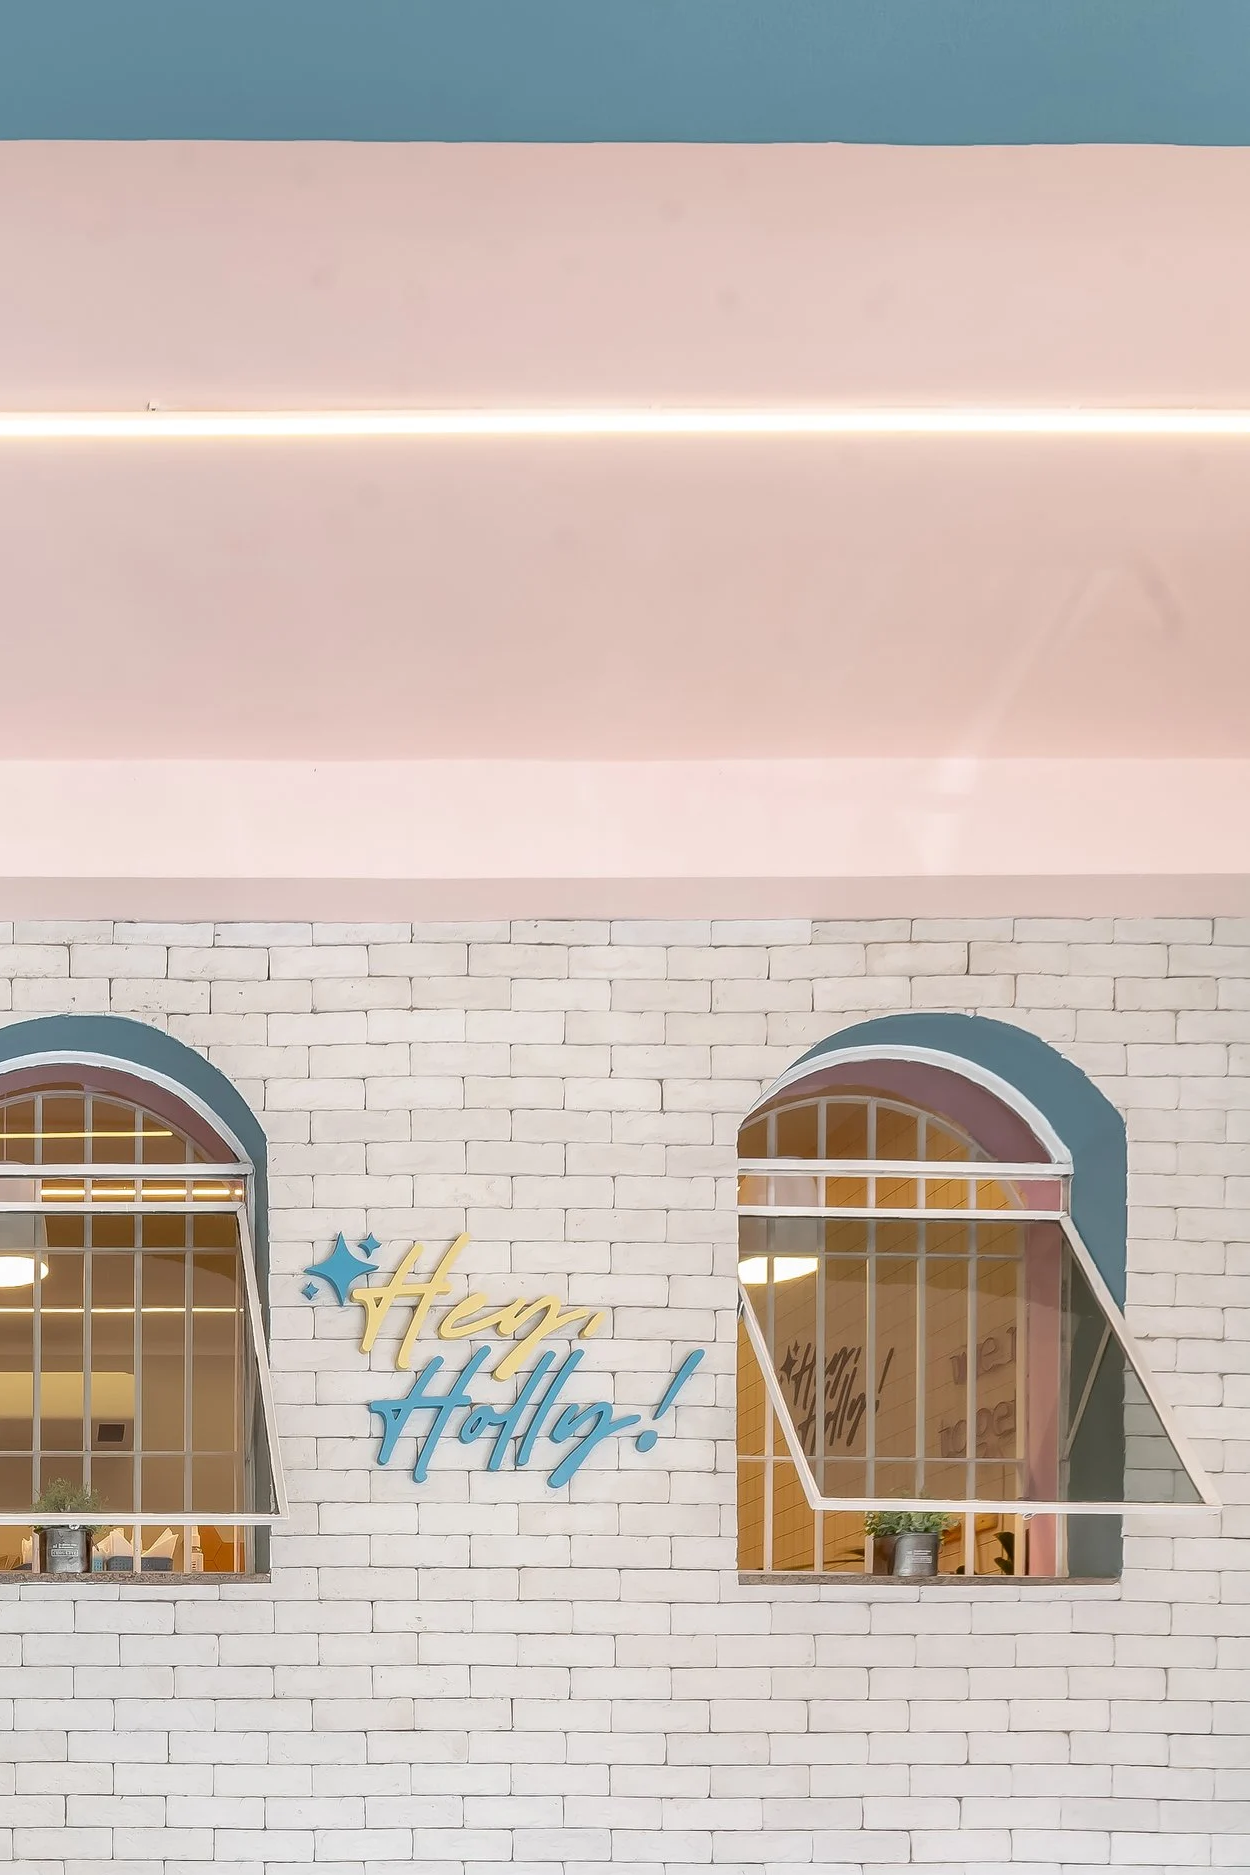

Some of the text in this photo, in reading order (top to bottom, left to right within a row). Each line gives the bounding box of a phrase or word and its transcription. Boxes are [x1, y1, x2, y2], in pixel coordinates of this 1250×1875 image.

[352, 1231, 607, 1382] Hey,
[791, 1342, 862, 1411] Hy,
[368, 1344, 706, 1489] Holly!
